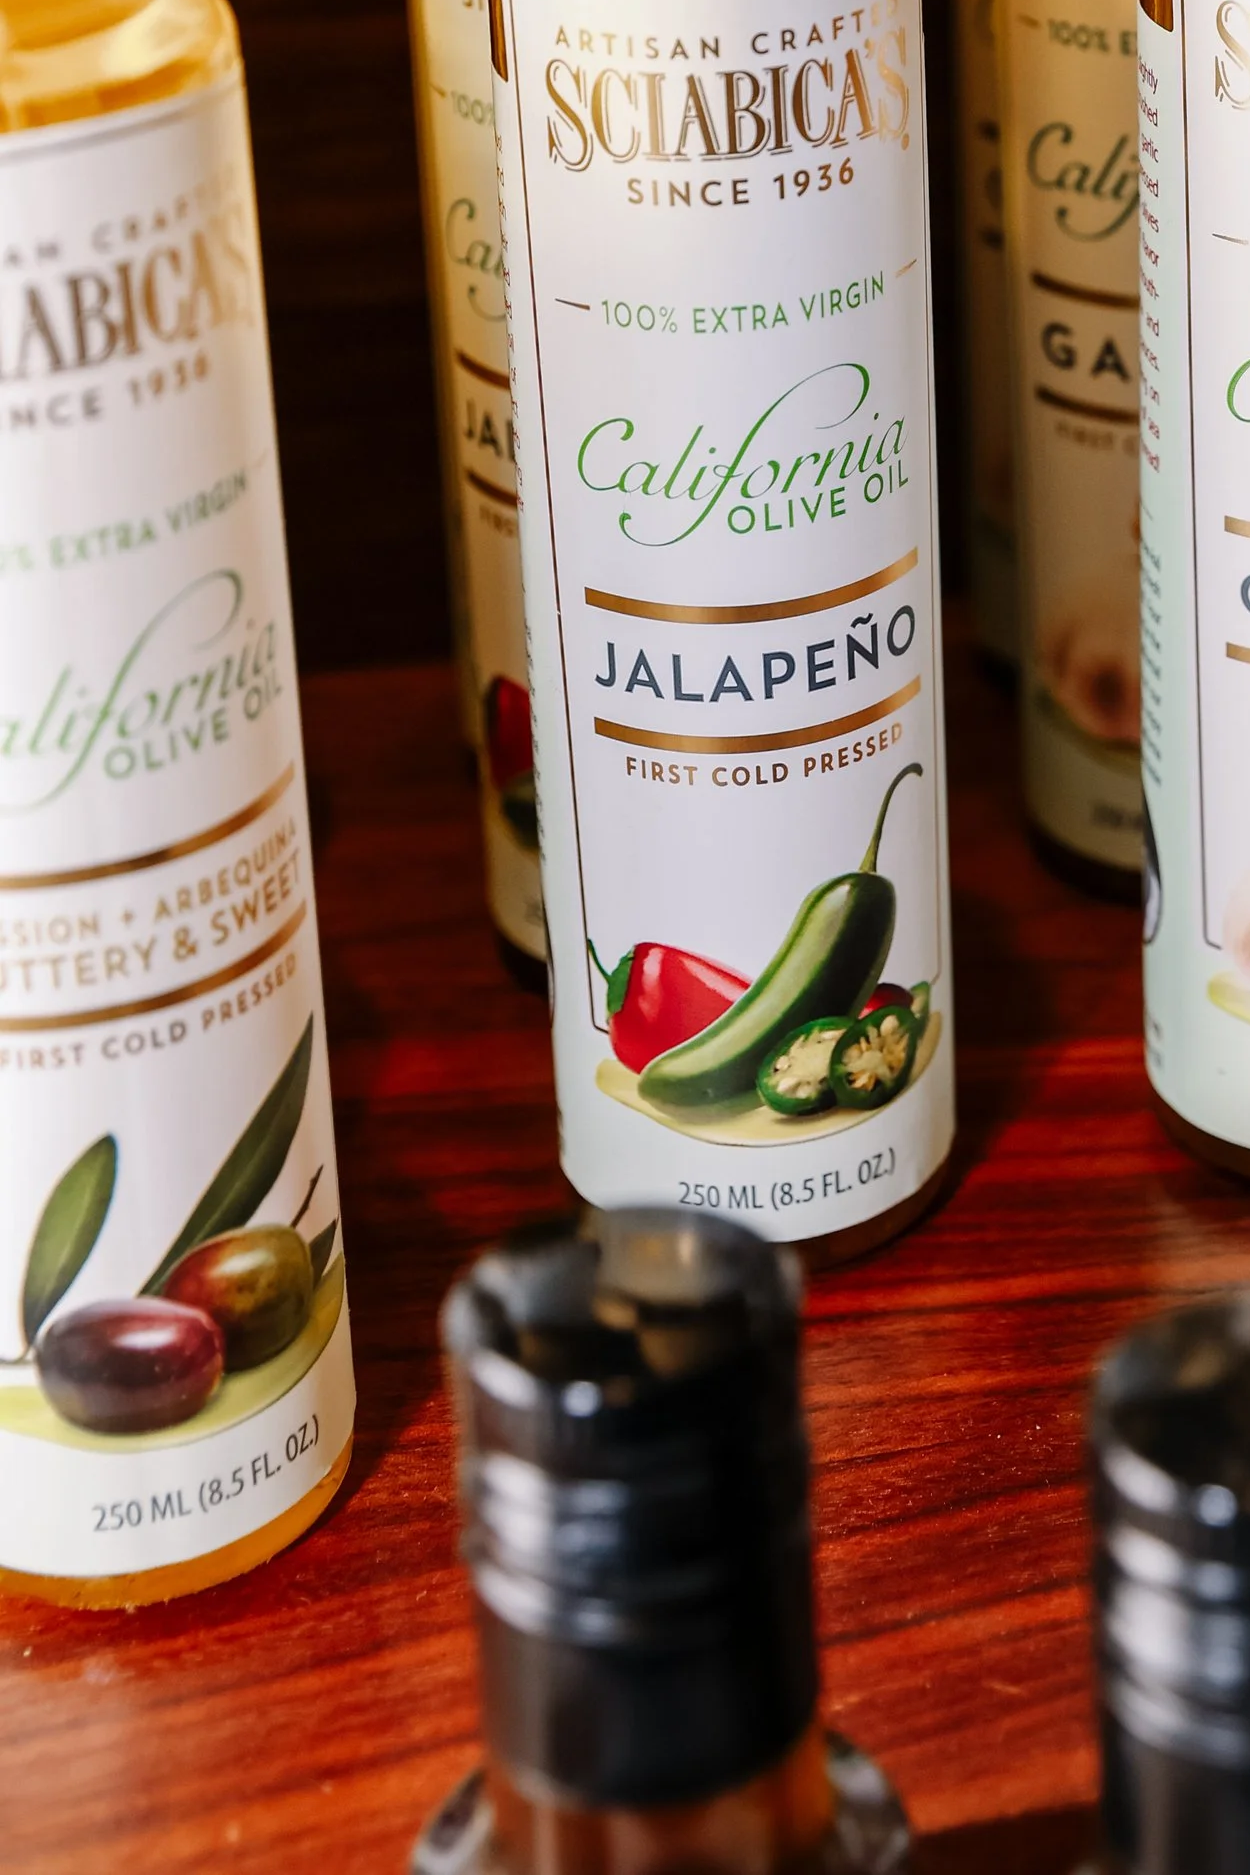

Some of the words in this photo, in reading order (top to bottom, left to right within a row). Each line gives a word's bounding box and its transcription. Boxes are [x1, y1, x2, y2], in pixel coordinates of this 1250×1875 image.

[554, 23, 721, 60] ARTISAN
[545, 24, 911, 173] SCIABICA'S
[627, 176, 750, 208] SINCE
[772, 155, 856, 201] 1936
[601, 298, 679, 334] 100%
[692, 298, 790, 335] EXTRA
[798, 268, 885, 323] VIRGIN
[127, 351, 211, 409] 1936
[576, 362, 910, 548] California
[726, 485, 848, 536] OLIVE
[861, 458, 911, 505] OIL
[48, 516, 156, 571] EXTRA
[166, 465, 248, 533] VIRGIN
[594, 604, 918, 704] JALAPEÑO
[103, 705, 231, 780] OLIVE
[243, 671, 283, 723] OIL
[625, 754, 699, 787] FIRST
[711, 761, 790, 789] COLD
[803, 720, 904, 779] PRESSED
[154, 816, 298, 923] ARBEQUINA
[171, 925, 200, 963] &
[211, 843, 302, 947] SWEET
[101, 1020, 189, 1062] COLD
[201, 953, 299, 1033] PRESSED
[677, 1180, 720, 1209] 250
[727, 1185, 764, 1210] ML
[769, 1175, 816, 1213] (8.5
[822, 1167, 854, 1199] FL.
[857, 1145, 898, 1185] OZ.)
[92, 1499, 144, 1535] 250
[149, 1489, 194, 1526] ML
[196, 1467, 247, 1515] (8.5
[249, 1449, 286, 1495] FL.
[284, 1411, 323, 1467] OZ.)
